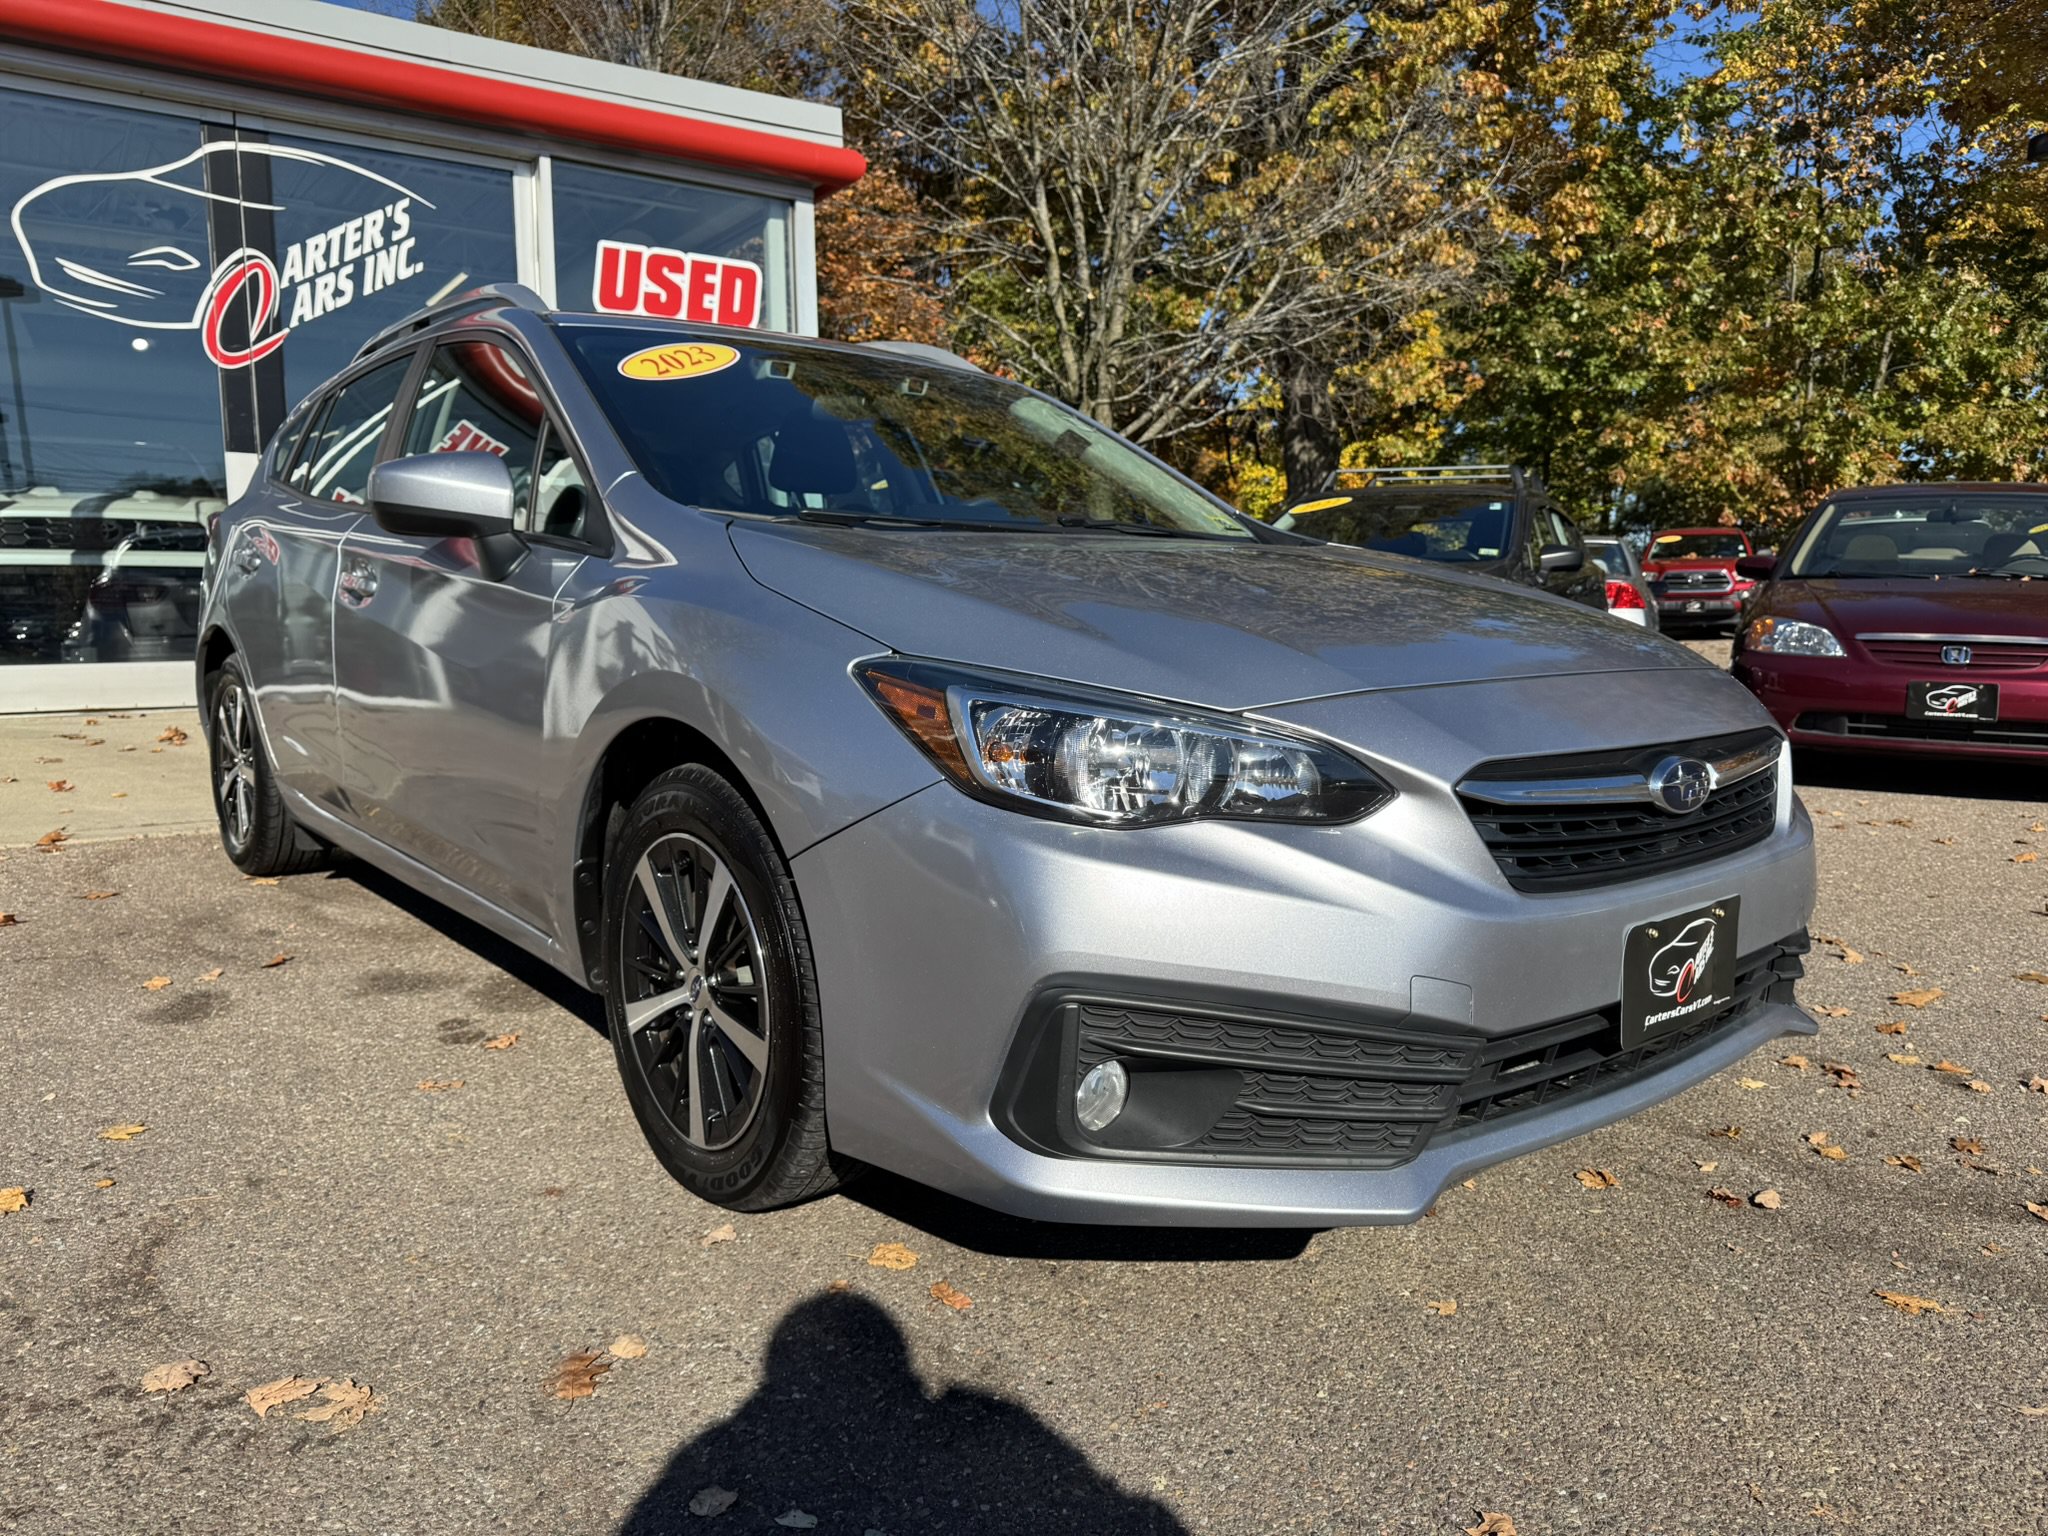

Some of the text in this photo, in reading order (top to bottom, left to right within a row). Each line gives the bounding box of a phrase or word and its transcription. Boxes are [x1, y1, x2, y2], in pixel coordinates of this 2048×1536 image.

[363, 236, 424, 296] INC.
[599, 246, 758, 328] USED
[640, 346, 716, 376] 2023
